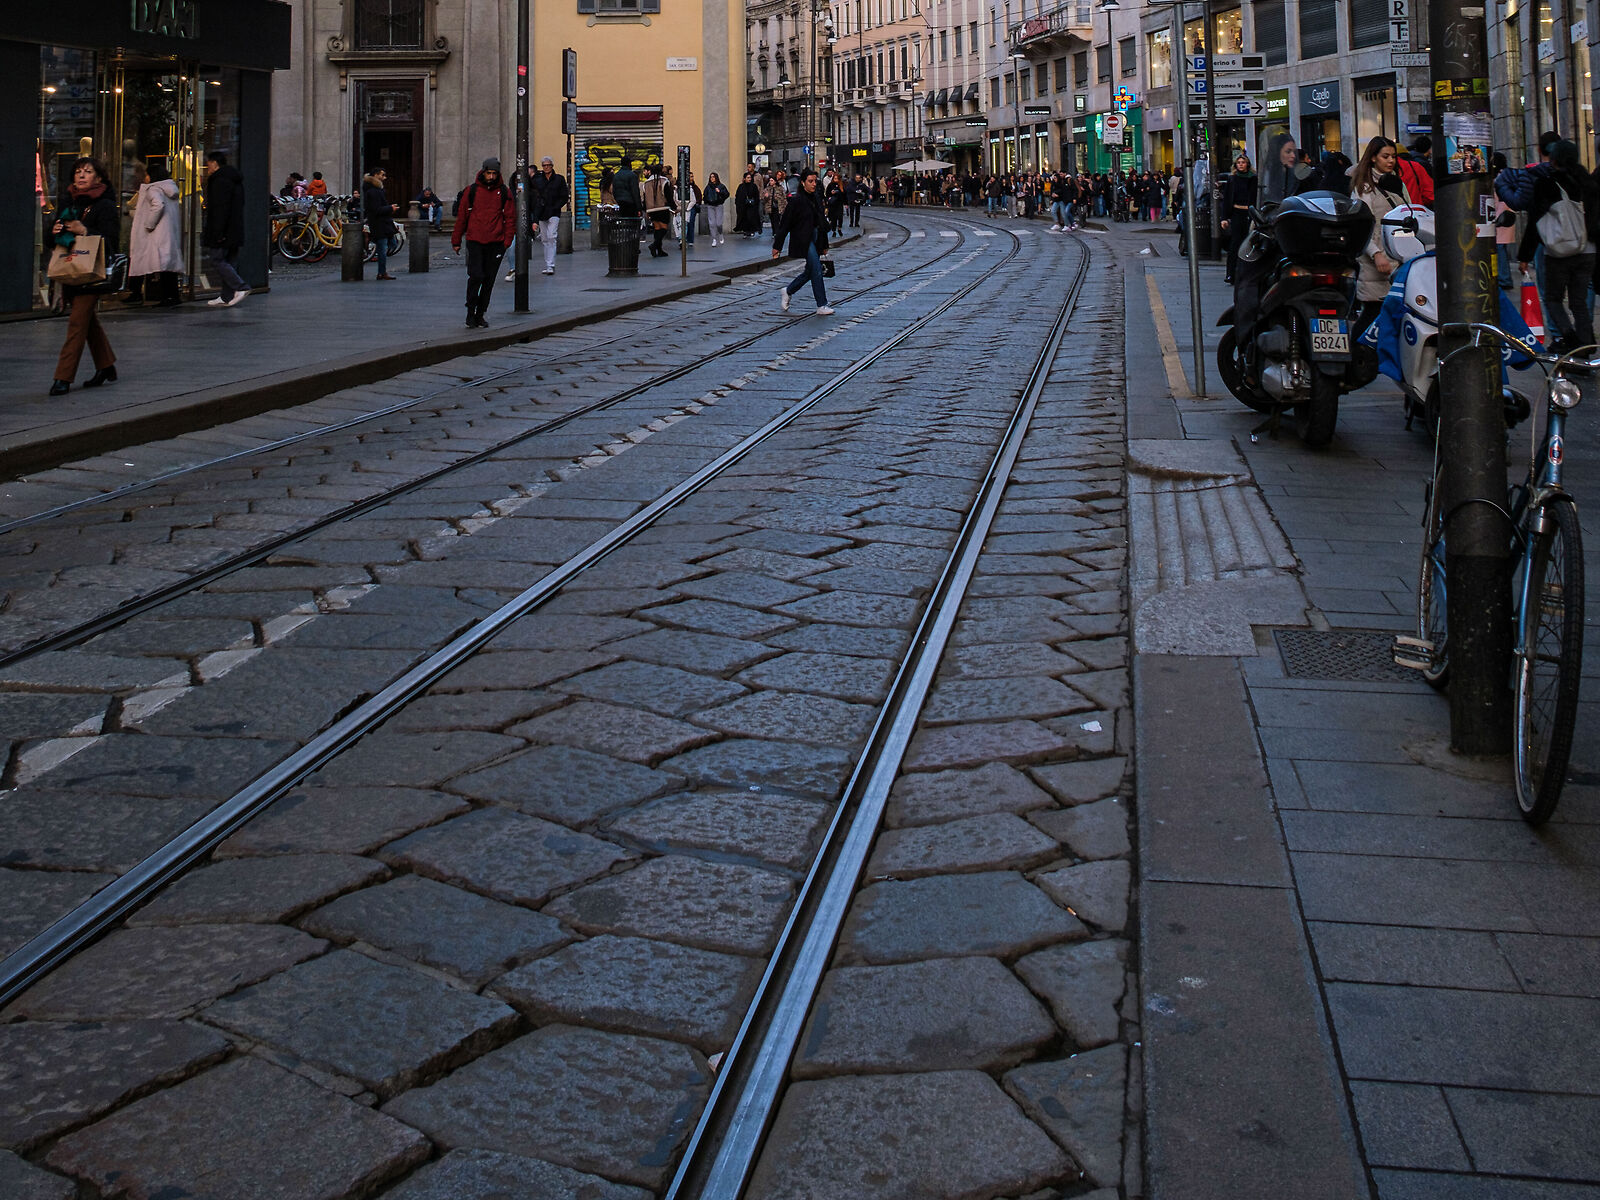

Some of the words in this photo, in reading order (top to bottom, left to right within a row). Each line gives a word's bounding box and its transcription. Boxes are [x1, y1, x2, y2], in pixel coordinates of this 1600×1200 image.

[1312, 88, 1329, 103] Capello
[1319, 320, 1333, 333] DG
[1314, 336, 1347, 349] 58241
